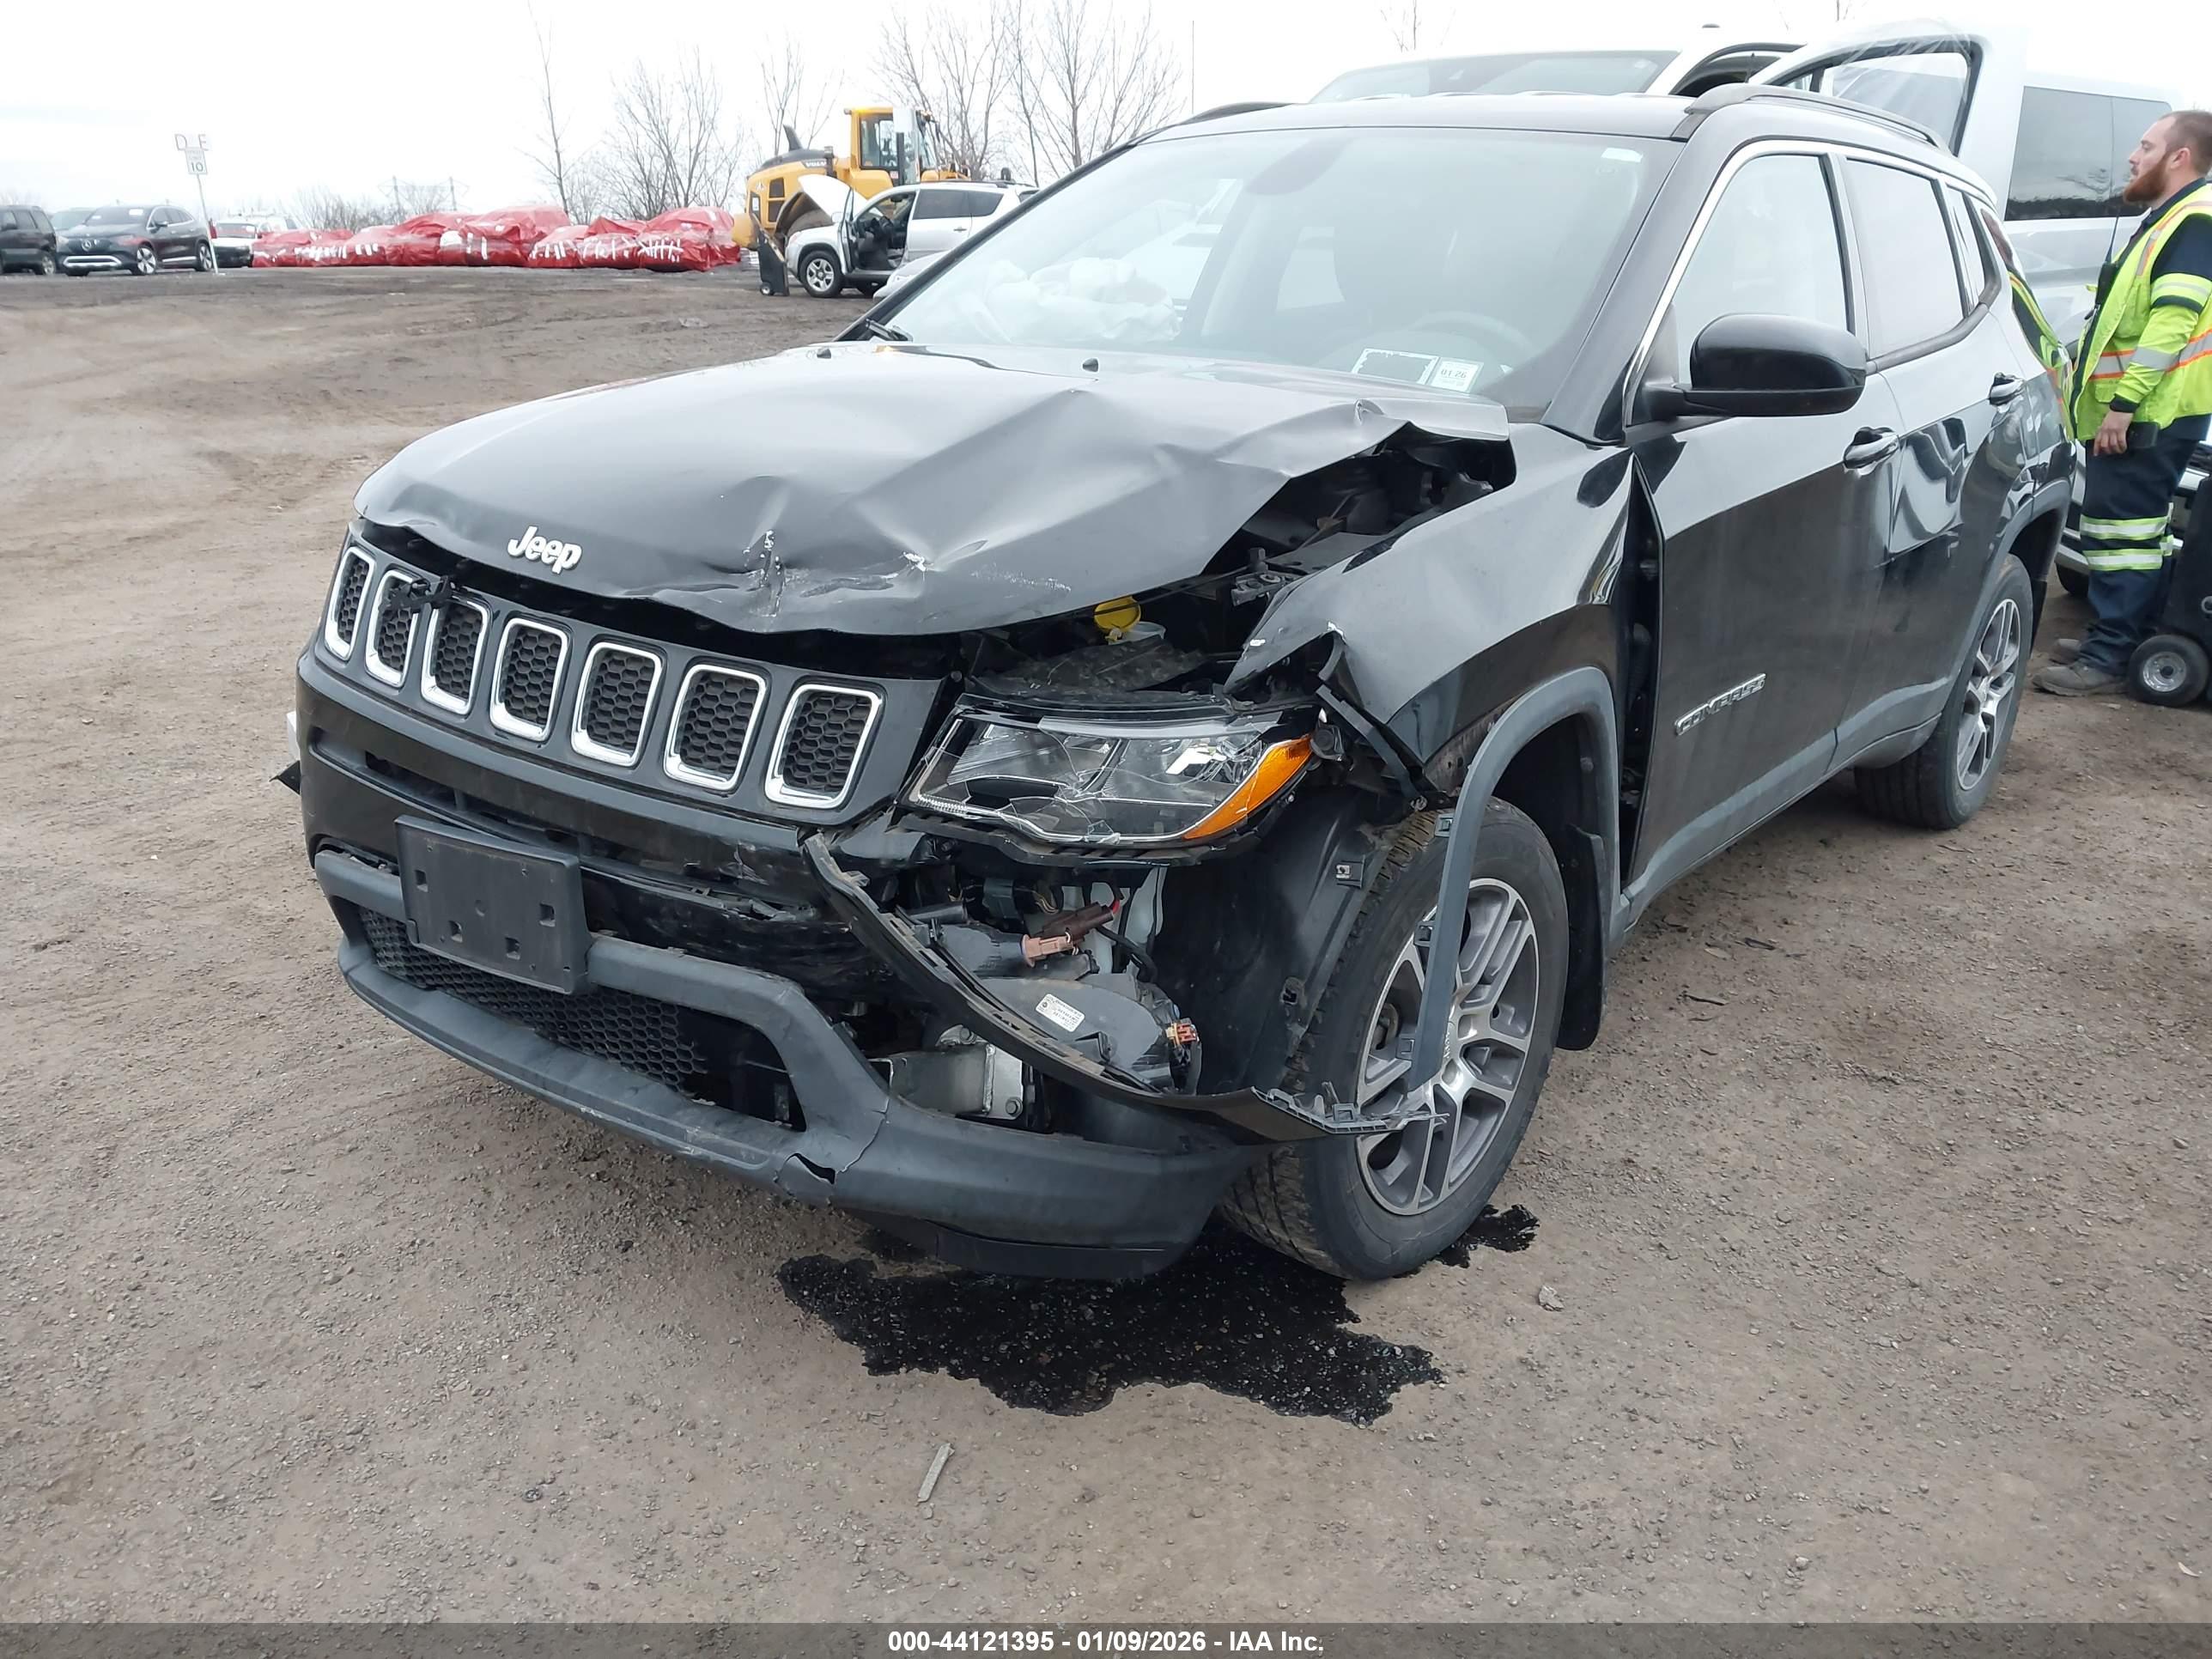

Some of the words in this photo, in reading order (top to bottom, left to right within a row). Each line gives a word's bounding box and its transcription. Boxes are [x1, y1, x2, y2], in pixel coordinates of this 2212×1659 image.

[191, 161, 204, 173] 10
[507, 526, 583, 574] Jeep
[1674, 672, 1766, 737] COMPASS
